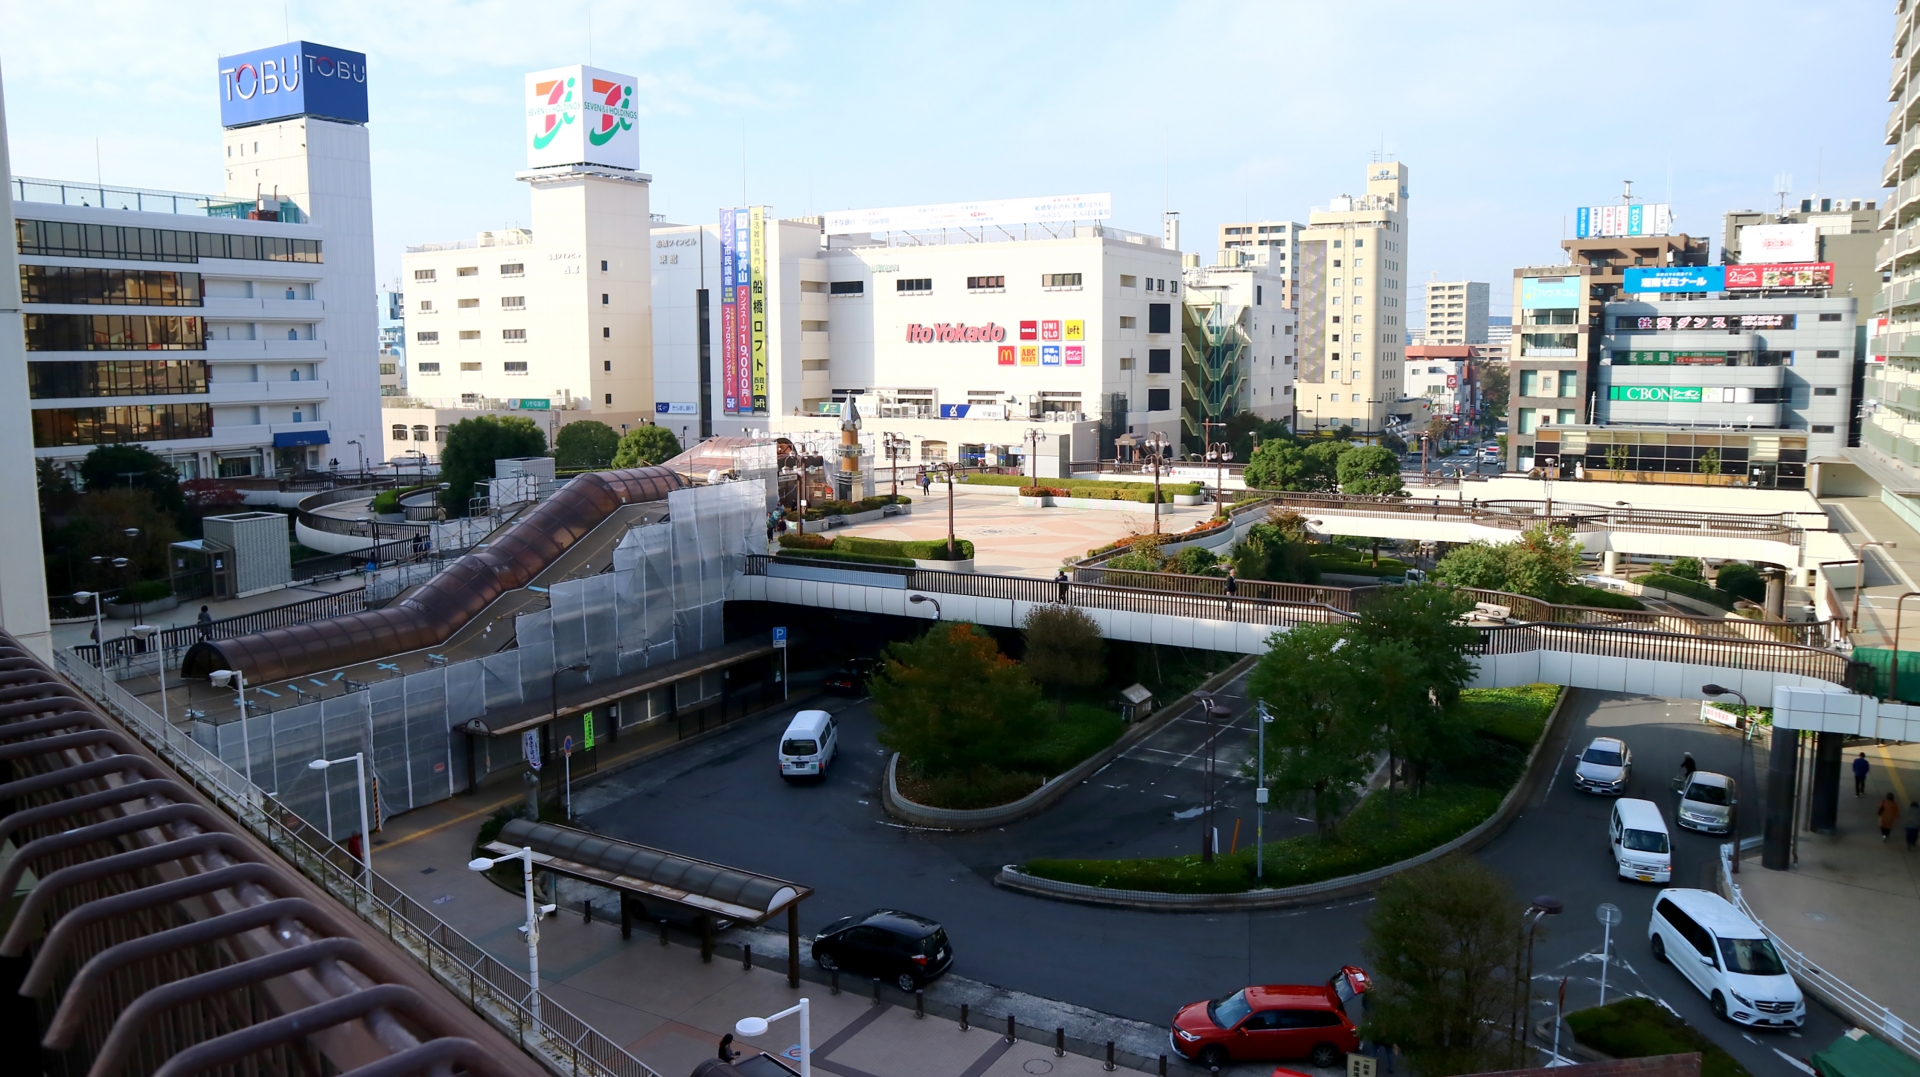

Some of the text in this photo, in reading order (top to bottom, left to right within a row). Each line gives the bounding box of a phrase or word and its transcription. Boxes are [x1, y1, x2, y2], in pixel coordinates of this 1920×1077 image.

[304, 54, 365, 84] TOBU
[221, 54, 300, 101] TOBU
[609, 107, 638, 120] HOLDINGS
[1631, 208, 1640, 232] NOVA
[722, 211, 733, 286] パソコン市民講座
[1640, 276, 1707, 288] 湘南ゼミナール
[1538, 289, 1577, 297] ハウスコム
[739, 289, 747, 332] メンズスーツ
[753, 280, 764, 372] 船橋ロフト
[1638, 316, 1726, 329] 社交ダンス
[1043, 354, 1058, 363] 青山
[525, 400, 546, 408] りそな銀行
[726, 398, 735, 409] 5F
[776, 628, 784, 639] P
